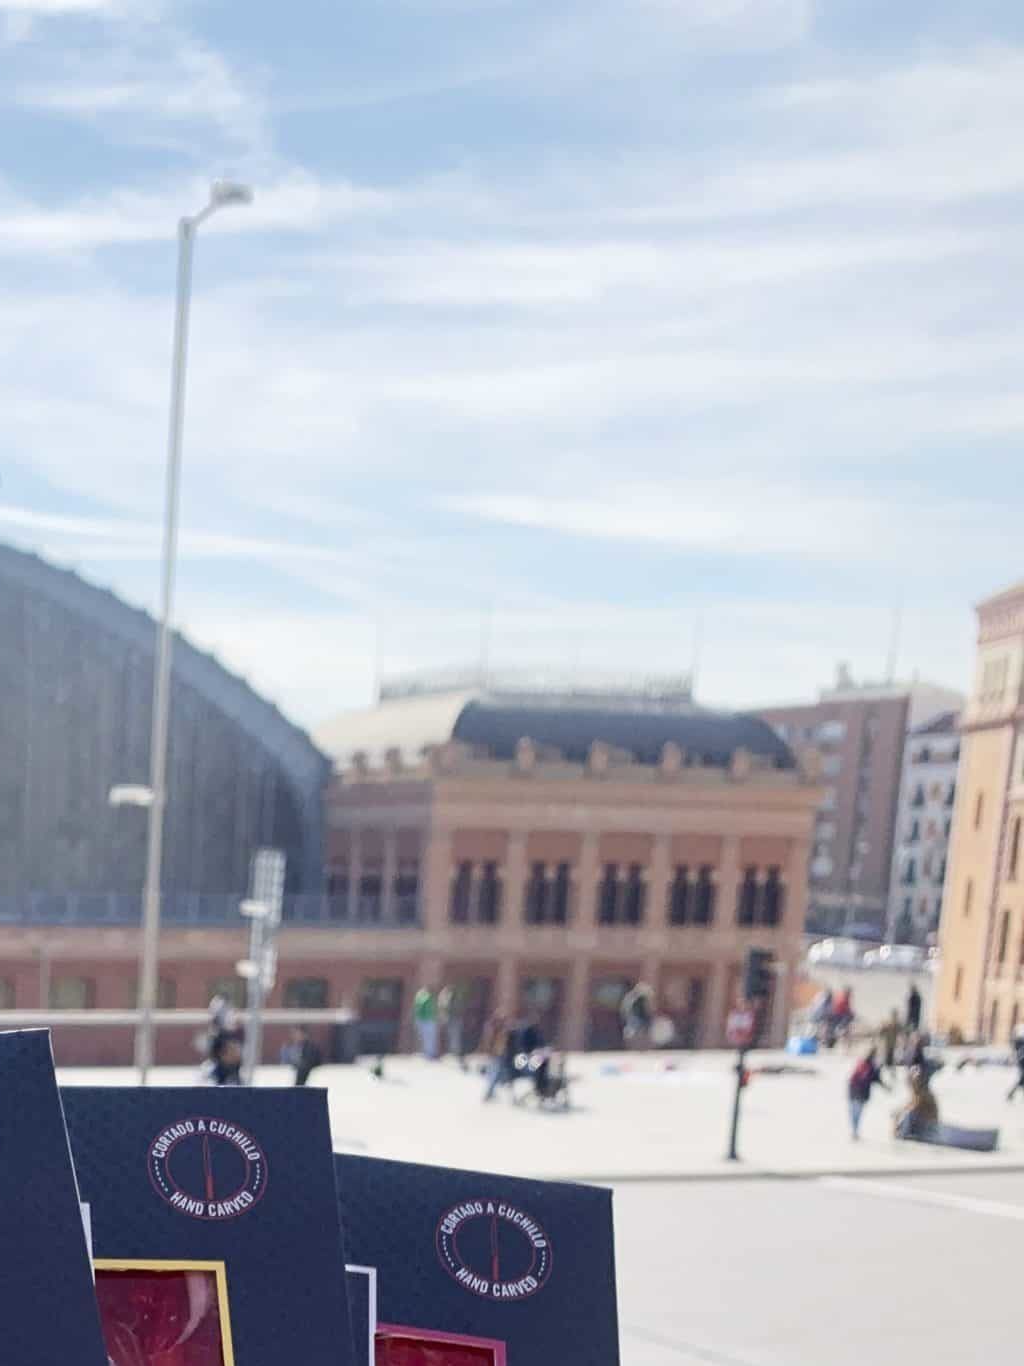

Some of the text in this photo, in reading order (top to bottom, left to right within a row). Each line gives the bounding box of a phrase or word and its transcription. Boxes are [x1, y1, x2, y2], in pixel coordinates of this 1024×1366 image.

[152, 1120, 260, 1161] CORTADO A CUCHILLO
[170, 1191, 254, 1216] HAND CARVED
[440, 1202, 547, 1248] CORTADO A CUCHILLO
[456, 1267, 538, 1297] HAND CARVED
